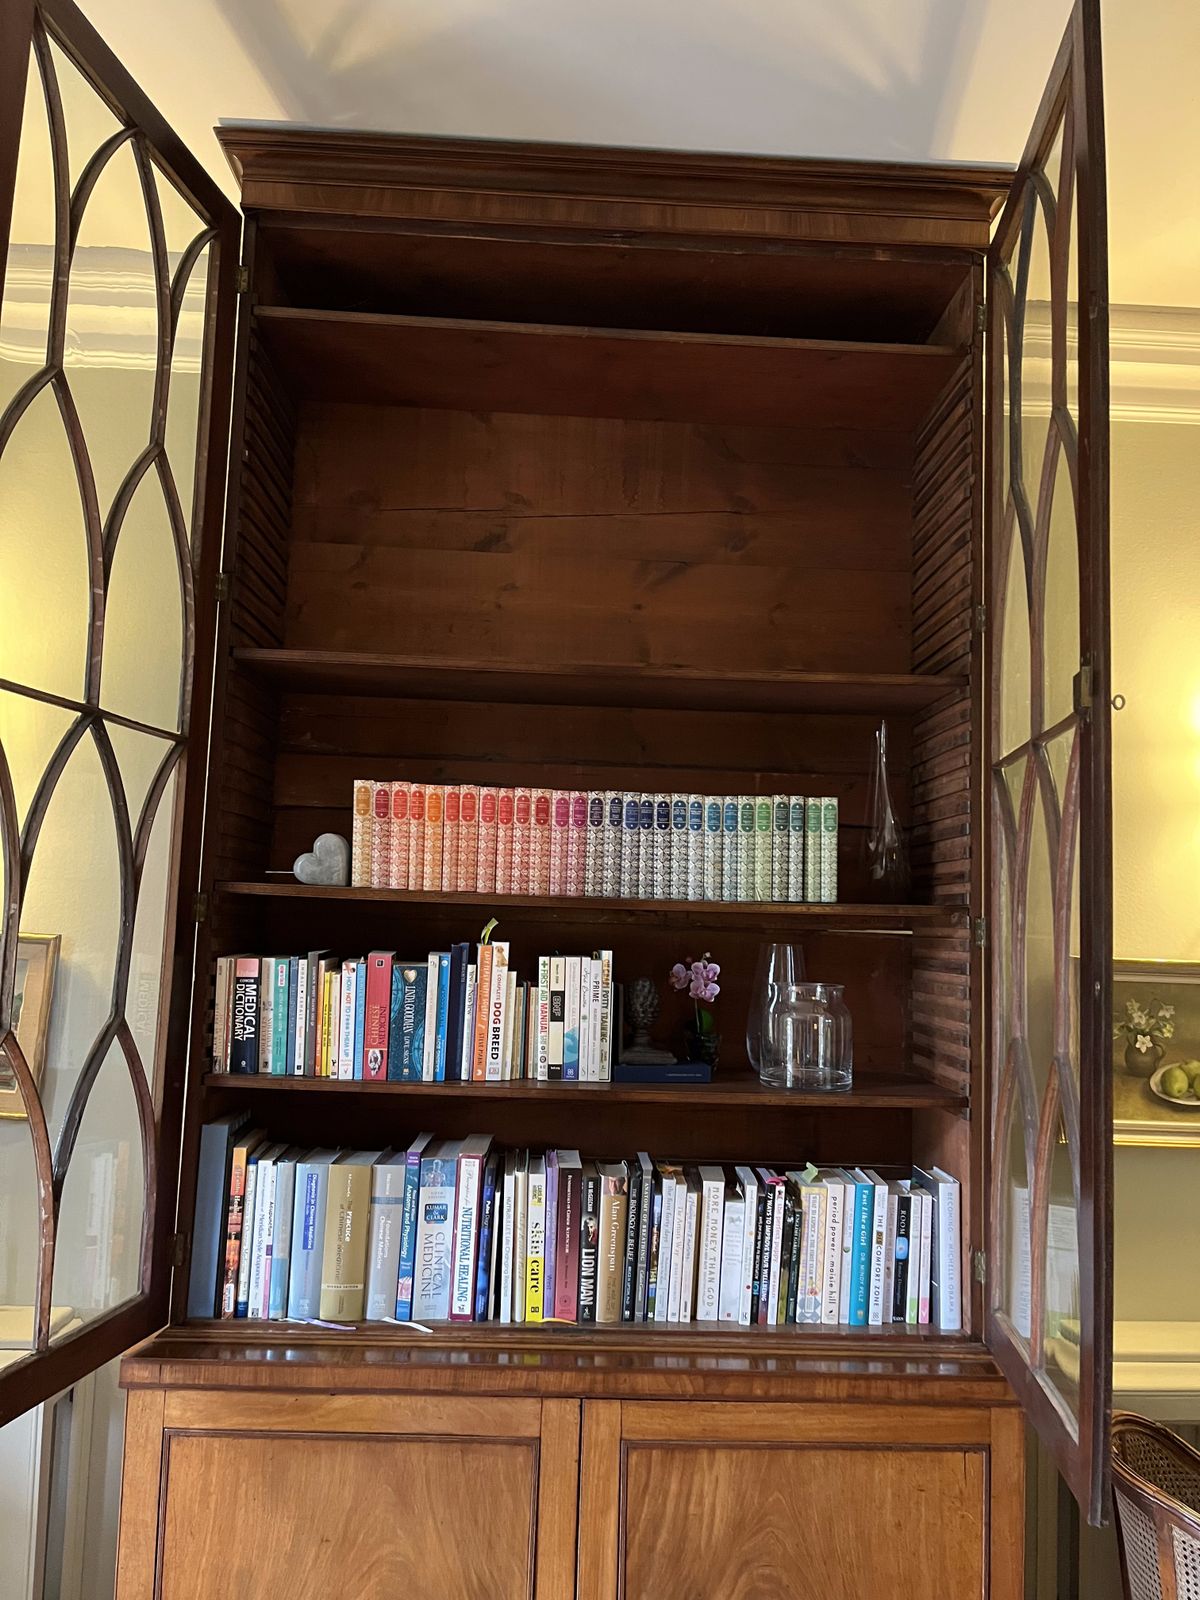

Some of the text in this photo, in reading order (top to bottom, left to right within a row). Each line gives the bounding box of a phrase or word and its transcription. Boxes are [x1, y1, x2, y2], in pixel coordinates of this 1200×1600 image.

[540, 969, 548, 988] FIRST
[345, 1005, 351, 1014] TO
[405, 986, 416, 1003] LINDA
[552, 996, 561, 1016] BNF
[234, 984, 245, 1041] DICTIONARY
[244, 984, 257, 1041] MEDICAL
[370, 1005, 379, 1045] CHINESE
[379, 1006, 387, 1044] MEDICINE
[403, 1003, 414, 1033] GOODMAN
[493, 1002, 502, 1024] DOG
[344, 1049, 349, 1057] UP
[491, 1026, 500, 1060] BREED
[309, 1174, 318, 1198] Diagnosis
[404, 1184, 413, 1212] Anatomy
[629, 1199, 637, 1229] BIOLOGY
[642, 1214, 648, 1223] OF
[830, 1196, 840, 1224] period
[258, 1214, 266, 1238] Meridian
[338, 1211, 346, 1242] Chinese
[401, 1225, 411, 1258] Physiology
[458, 1207, 473, 1263] NUTRITIONAL
[608, 1200, 620, 1272] Alan Greenspan
[763, 1225, 771, 1251] IMPROVE
[828, 1226, 838, 1252] power
[376, 1216, 386, 1269] Chinese Medicine
[530, 1222, 545, 1294] skin care
[706, 1187, 719, 1307] MORE MONEY THAN GOD
[772, 1241, 781, 1262] puppy
[335, 1245, 344, 1281] Medicine
[420, 1233, 434, 1300] MEDICINE
[431, 1232, 445, 1299] CLINICAL
[580, 1248, 595, 1305] LION MAN
[457, 1264, 470, 1302] HEALING
[760, 1268, 769, 1301] WELLBEING
[828, 1290, 836, 1304] hill
